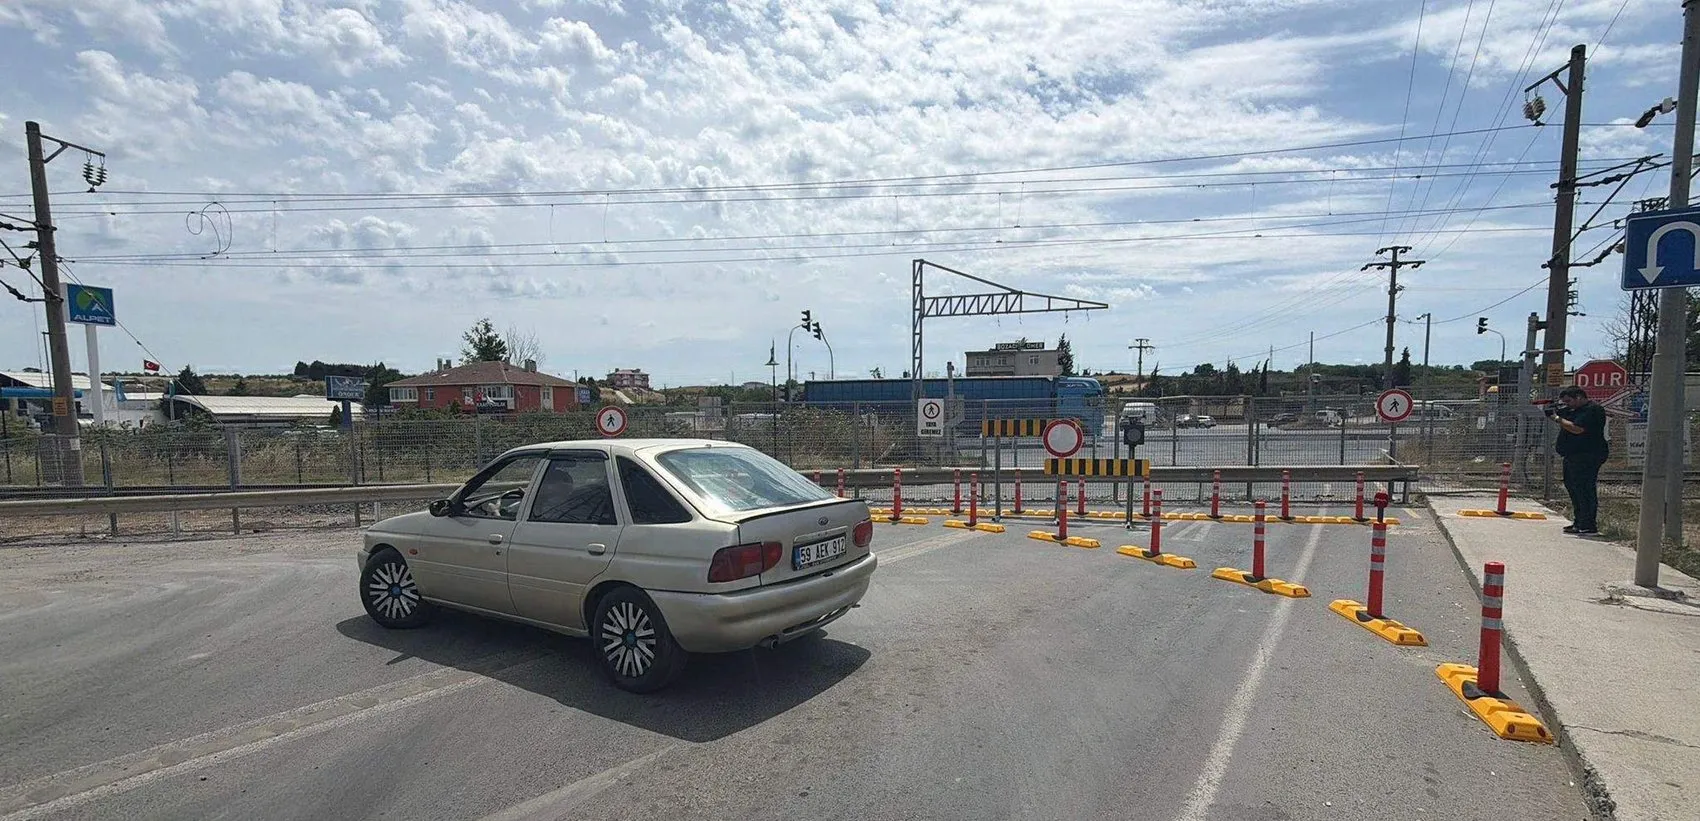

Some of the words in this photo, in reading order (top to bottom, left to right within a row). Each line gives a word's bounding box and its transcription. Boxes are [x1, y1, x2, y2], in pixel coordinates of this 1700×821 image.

[74, 314, 111, 323] ALPET
[1577, 372, 1622, 387] DUR
[800, 547, 811, 563] 59
[815, 542, 829, 559] AEK
[832, 538, 845, 554] 912
